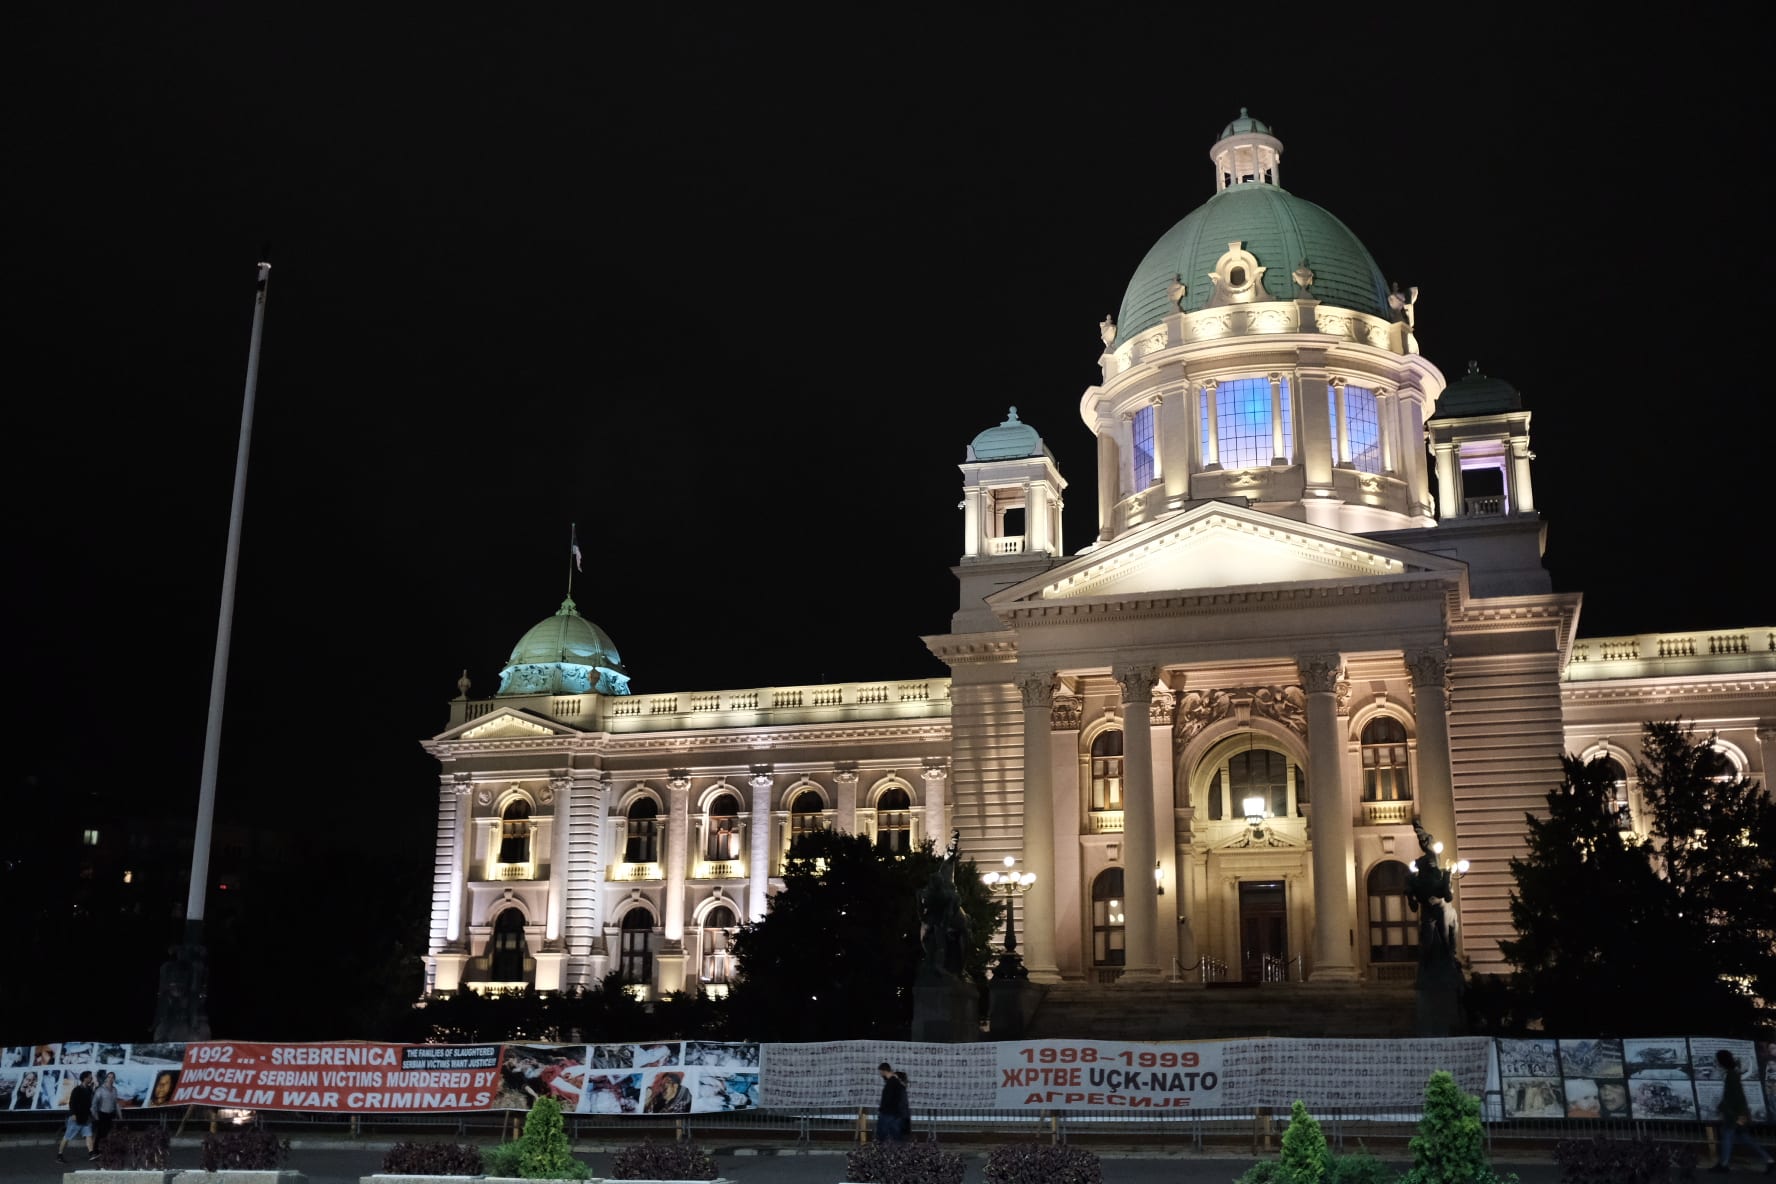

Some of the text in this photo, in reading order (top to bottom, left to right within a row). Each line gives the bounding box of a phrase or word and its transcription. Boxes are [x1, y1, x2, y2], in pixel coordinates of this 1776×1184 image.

[189, 1046, 234, 1064] 1992
[271, 1047, 397, 1065] SREBRENICA
[408, 1048, 495, 1058] THE FAMILIES OF SLAUGHTERED
[402, 1060, 426, 1069] SERBIAN
[426, 1059, 450, 1069] VICTIMS
[450, 1058, 468, 1068] WANT
[181, 1067, 496, 1088] INNOCENT SERBIAN VICTIMS MURDERED BY
[1001, 1067, 1218, 1093] ЖРТВЕ UÇK-NATO
[173, 1085, 491, 1108] MUSLIM WAR CRIMINALS
[1024, 1091, 1192, 1108] АГРЕСИЈЕ
